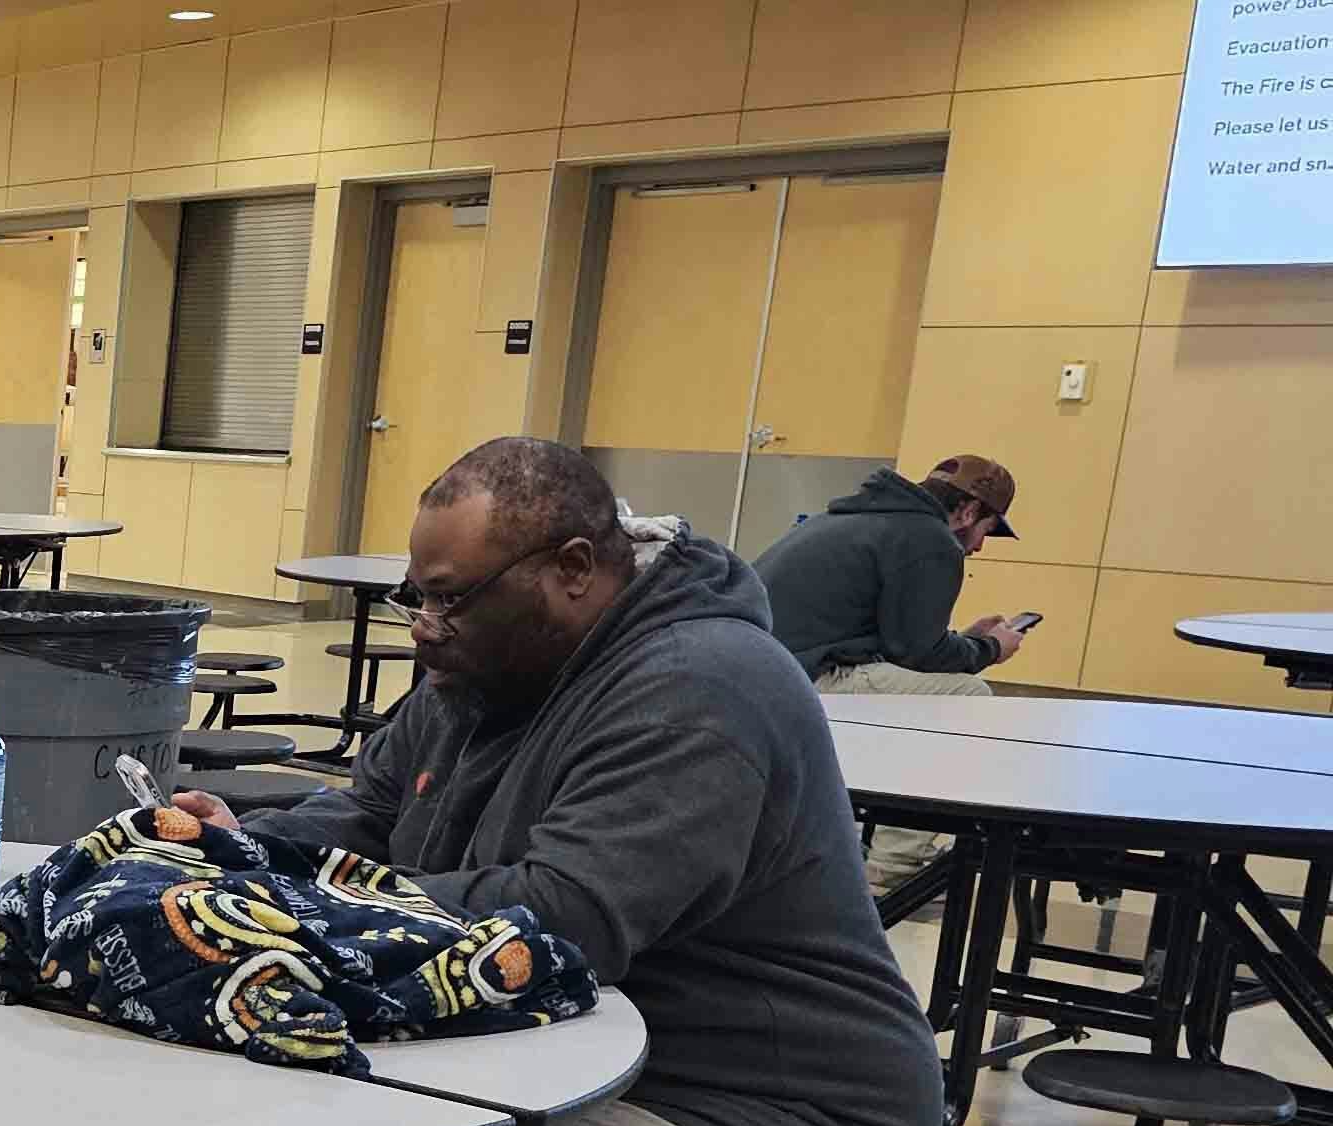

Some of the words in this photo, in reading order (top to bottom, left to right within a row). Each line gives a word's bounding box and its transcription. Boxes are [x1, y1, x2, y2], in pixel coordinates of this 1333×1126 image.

[1232, 0, 1290, 18] power
[1227, 35, 1328, 56] Evacuation
[1221, 82, 1254, 96] The
[1259, 78, 1294, 94] Fire
[1300, 75, 1316, 90] is
[1213, 120, 1274, 136] Please
[1279, 117, 1301, 133] let
[1308, 119, 1329, 131] us
[1208, 161, 1262, 176] Water
[1267, 157, 1301, 174] and
